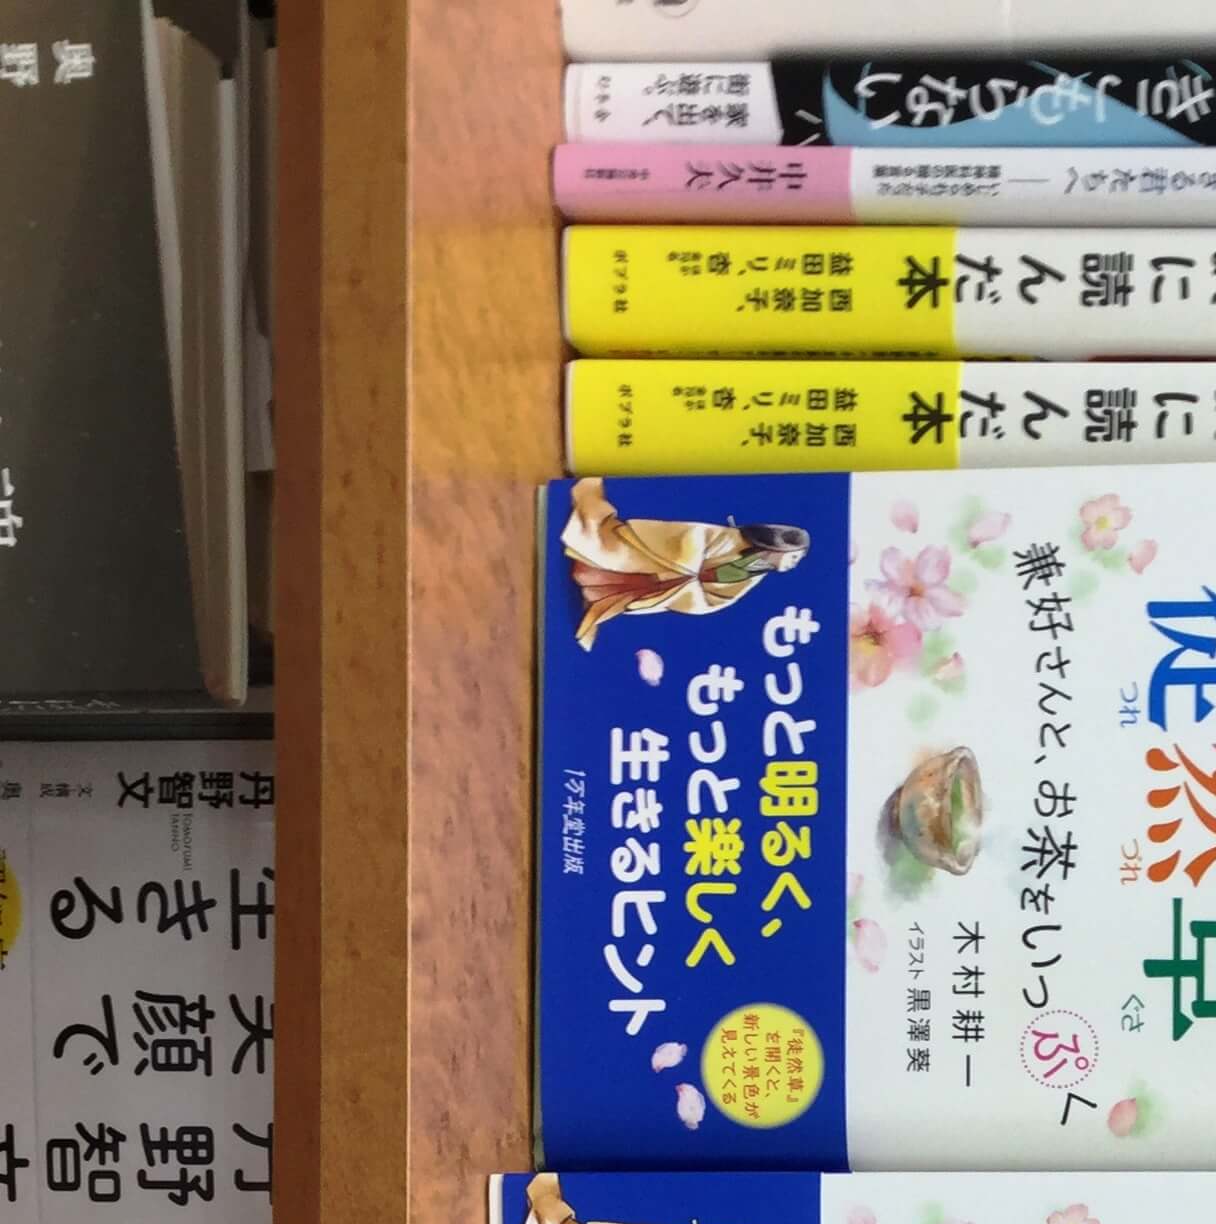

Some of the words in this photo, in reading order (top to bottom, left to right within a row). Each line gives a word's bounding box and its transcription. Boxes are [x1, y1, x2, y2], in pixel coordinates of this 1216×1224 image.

[1118, 680, 1141, 729] つれ
[116, 771, 276, 809] 丹野智文
[759, 605, 821, 939] もっと明るく、
[561, 768, 588, 876] 1万年堂出版
[683, 663, 745, 969] もっと楽しく
[1012, 542, 1098, 1126] 兼好さんと、お茶をいっぷく
[603, 726, 671, 1037] 生きるヒント
[1118, 838, 1143, 886] づれ
[907, 920, 926, 980] イラスト
[906, 986, 932, 1074] 黒澤葵
[950, 920, 986, 1088] 木村耕一
[1120, 993, 1146, 1034] ぐさ
[718, 1026, 739, 1107] 見えてくる
[740, 1012, 761, 1120] 新しい景色が
[762, 1029, 783, 1100] を開くと、
[783, 1022, 807, 1108] 『徒然草』
